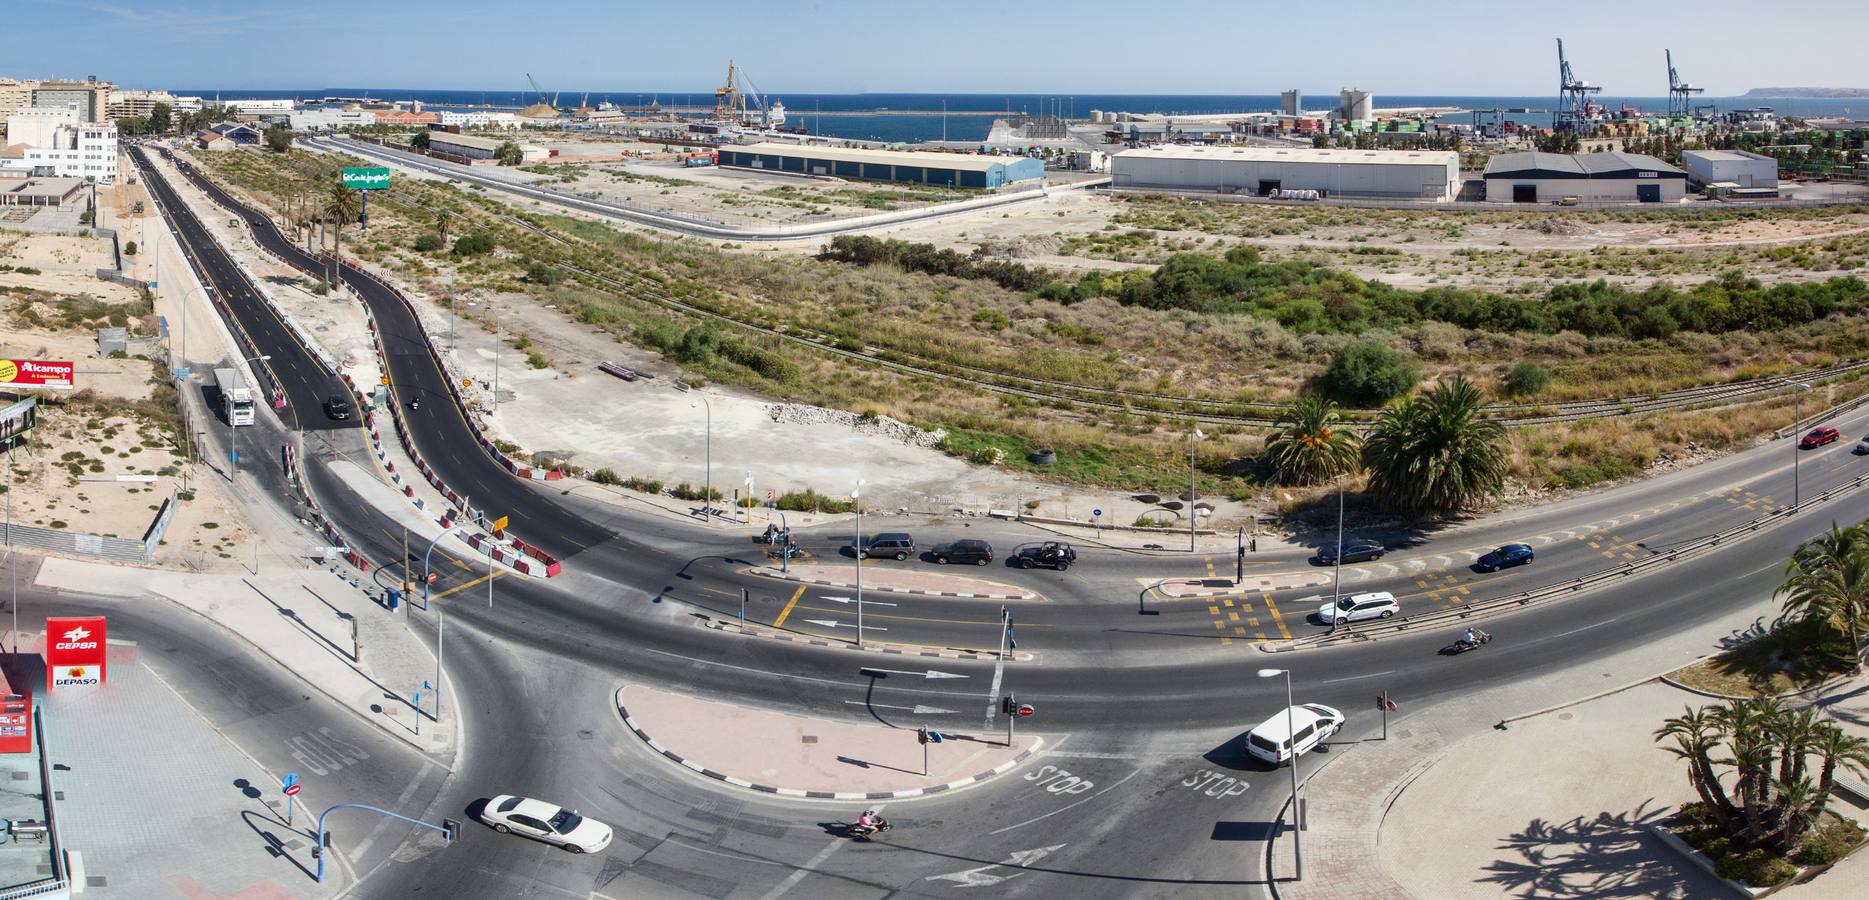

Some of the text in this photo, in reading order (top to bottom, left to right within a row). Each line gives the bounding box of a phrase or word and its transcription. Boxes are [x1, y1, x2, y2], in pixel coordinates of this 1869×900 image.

[21, 362, 71, 374] Alcampo
[56, 642, 97, 650] CEPSA
[283, 727, 370, 776] STOP
[1024, 765, 1094, 795] STOP
[1182, 769, 1250, 799] STOP
